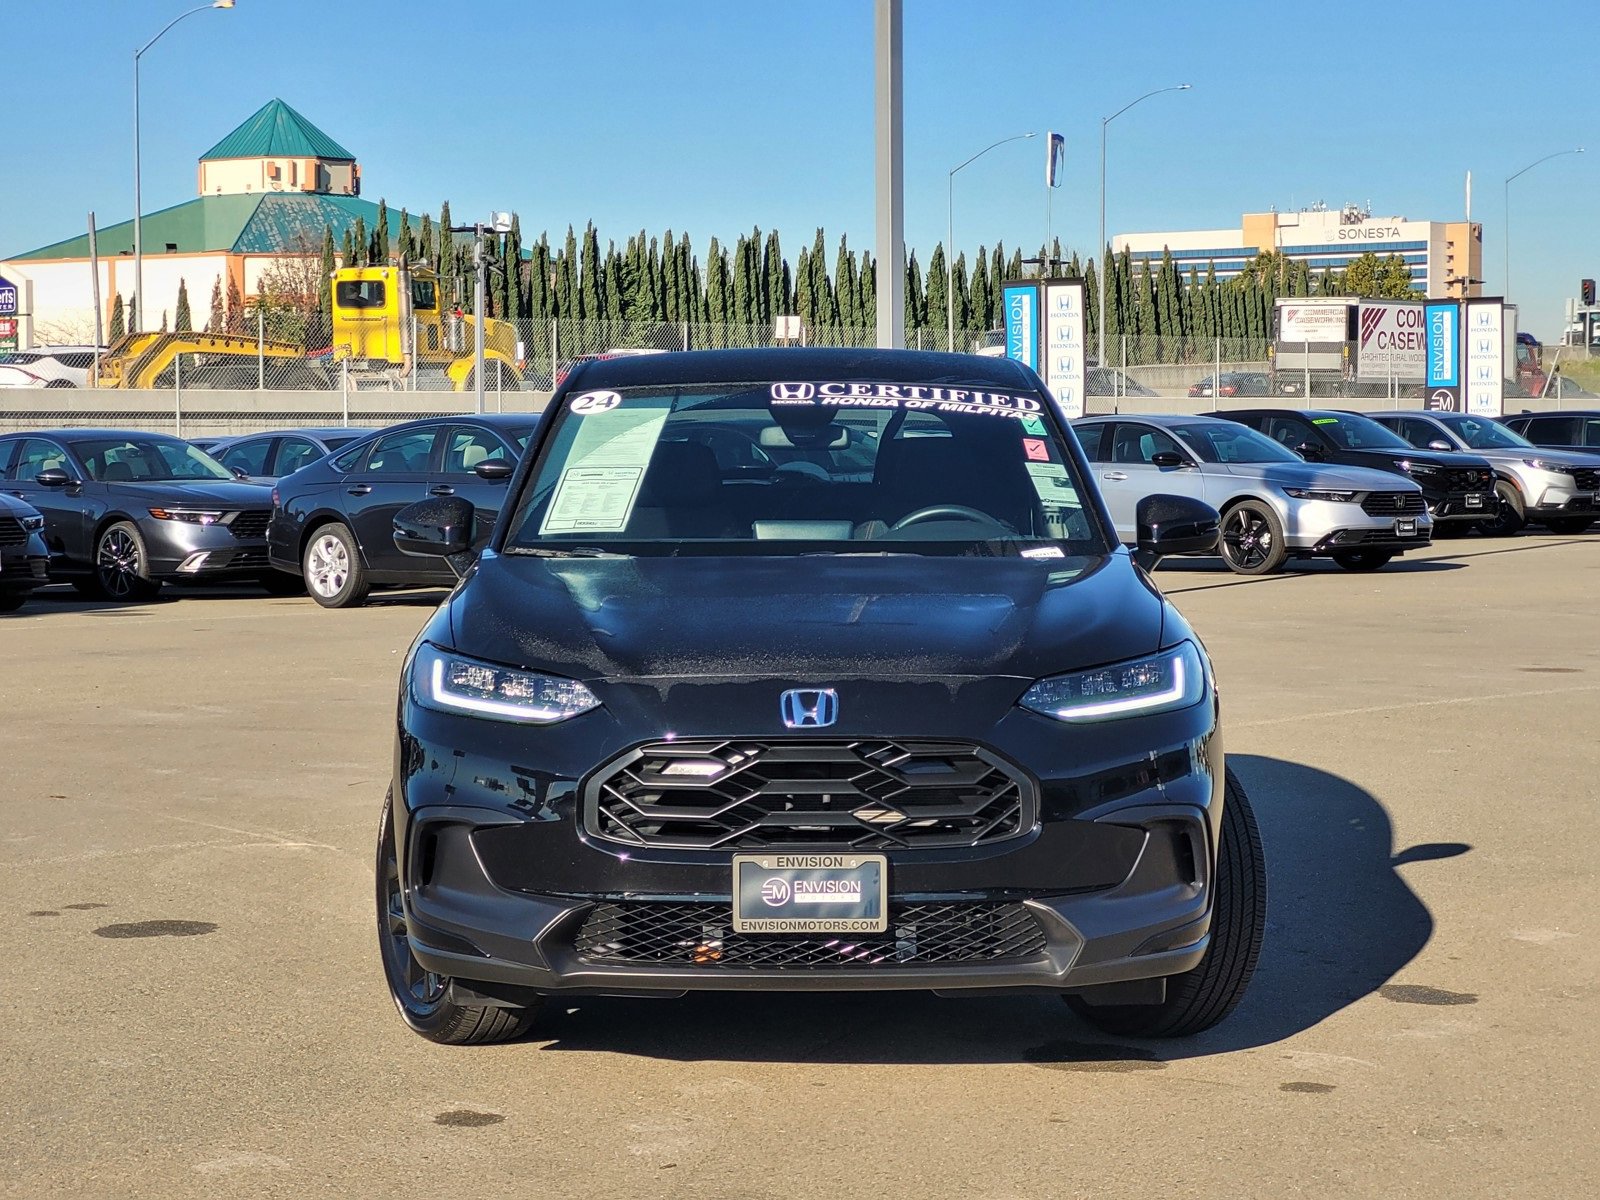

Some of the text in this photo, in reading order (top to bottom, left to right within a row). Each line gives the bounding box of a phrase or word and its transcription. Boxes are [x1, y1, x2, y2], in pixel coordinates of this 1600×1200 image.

[1338, 227, 1401, 240] SONESTA
[1433, 311, 1444, 380] ENVISION
[575, 394, 616, 411] 24
[819, 383, 1041, 411] CERTIFIED
[821, 397, 1039, 420] HONDA OF MILPITAS
[776, 856, 843, 868] ENVISION
[794, 880, 861, 893] ENVISION
[741, 921, 880, 931] ENVISIONMOTORS.COM
